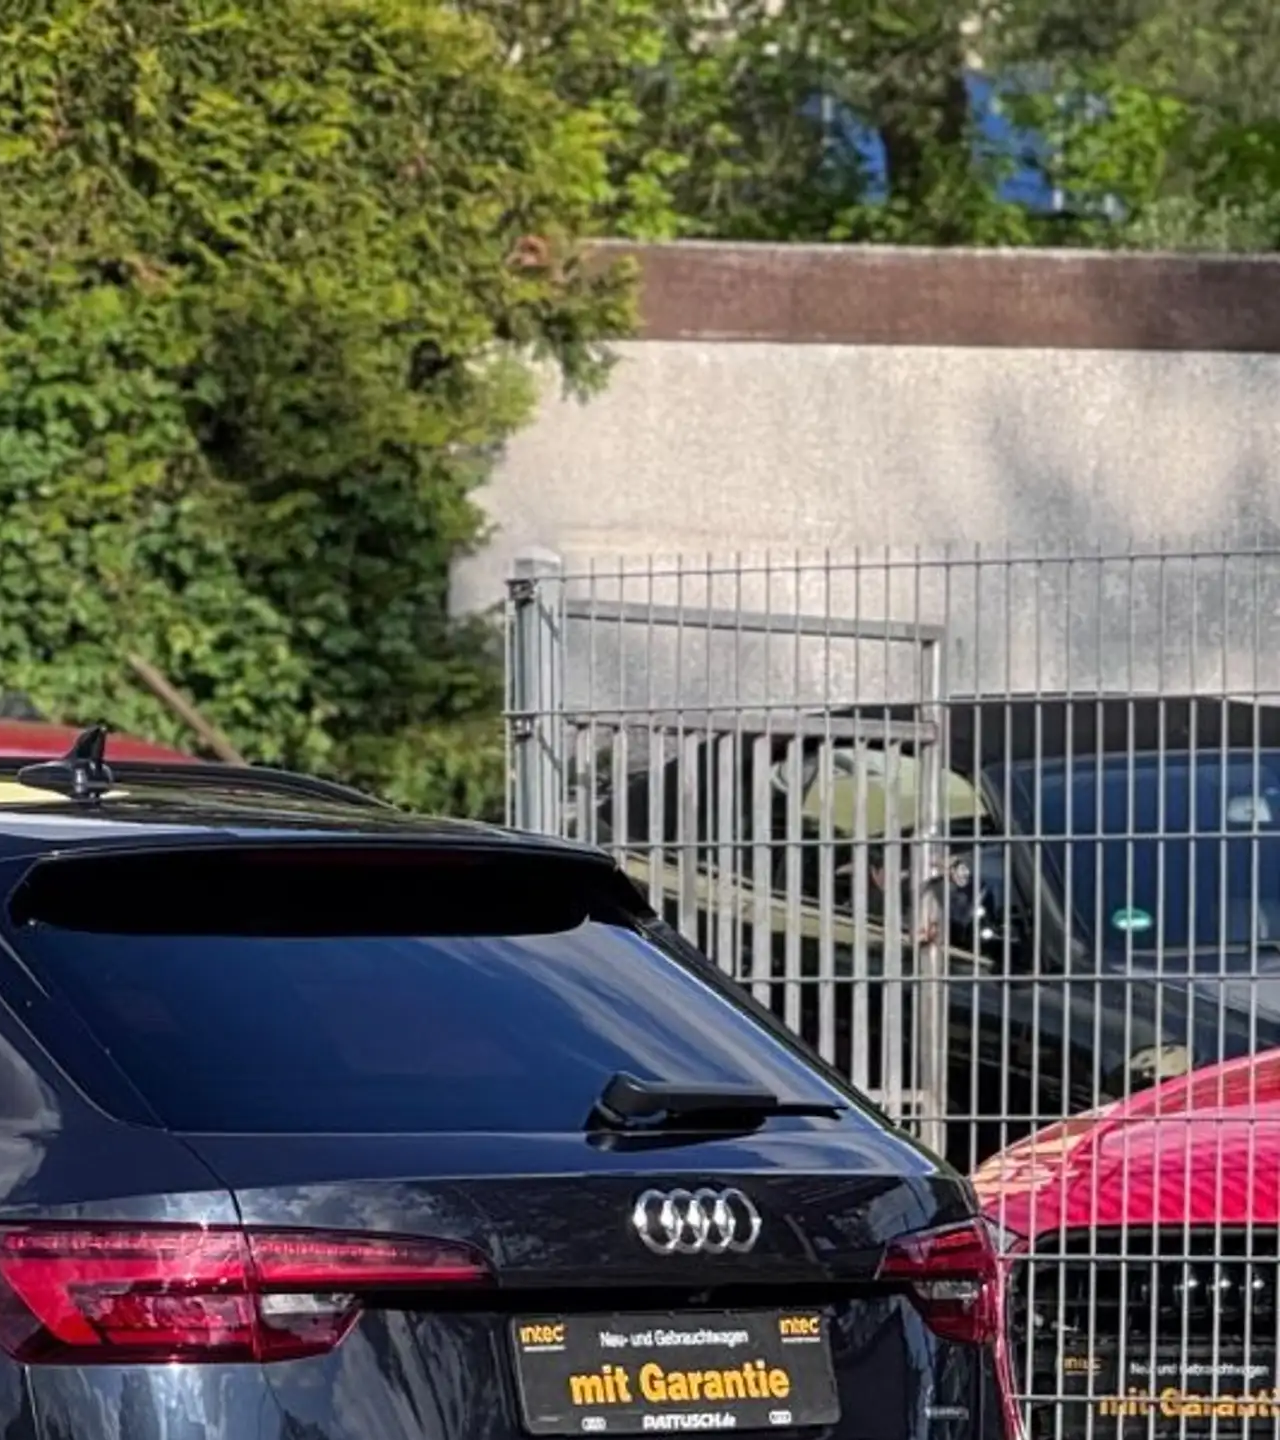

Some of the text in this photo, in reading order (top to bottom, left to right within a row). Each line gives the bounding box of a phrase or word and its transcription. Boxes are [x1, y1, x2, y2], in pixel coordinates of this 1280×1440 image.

[631, 1329, 653, 1347] und
[654, 1328, 749, 1349] Gebrauchtwagen
[570, 1359, 791, 1405] mit Garantie
